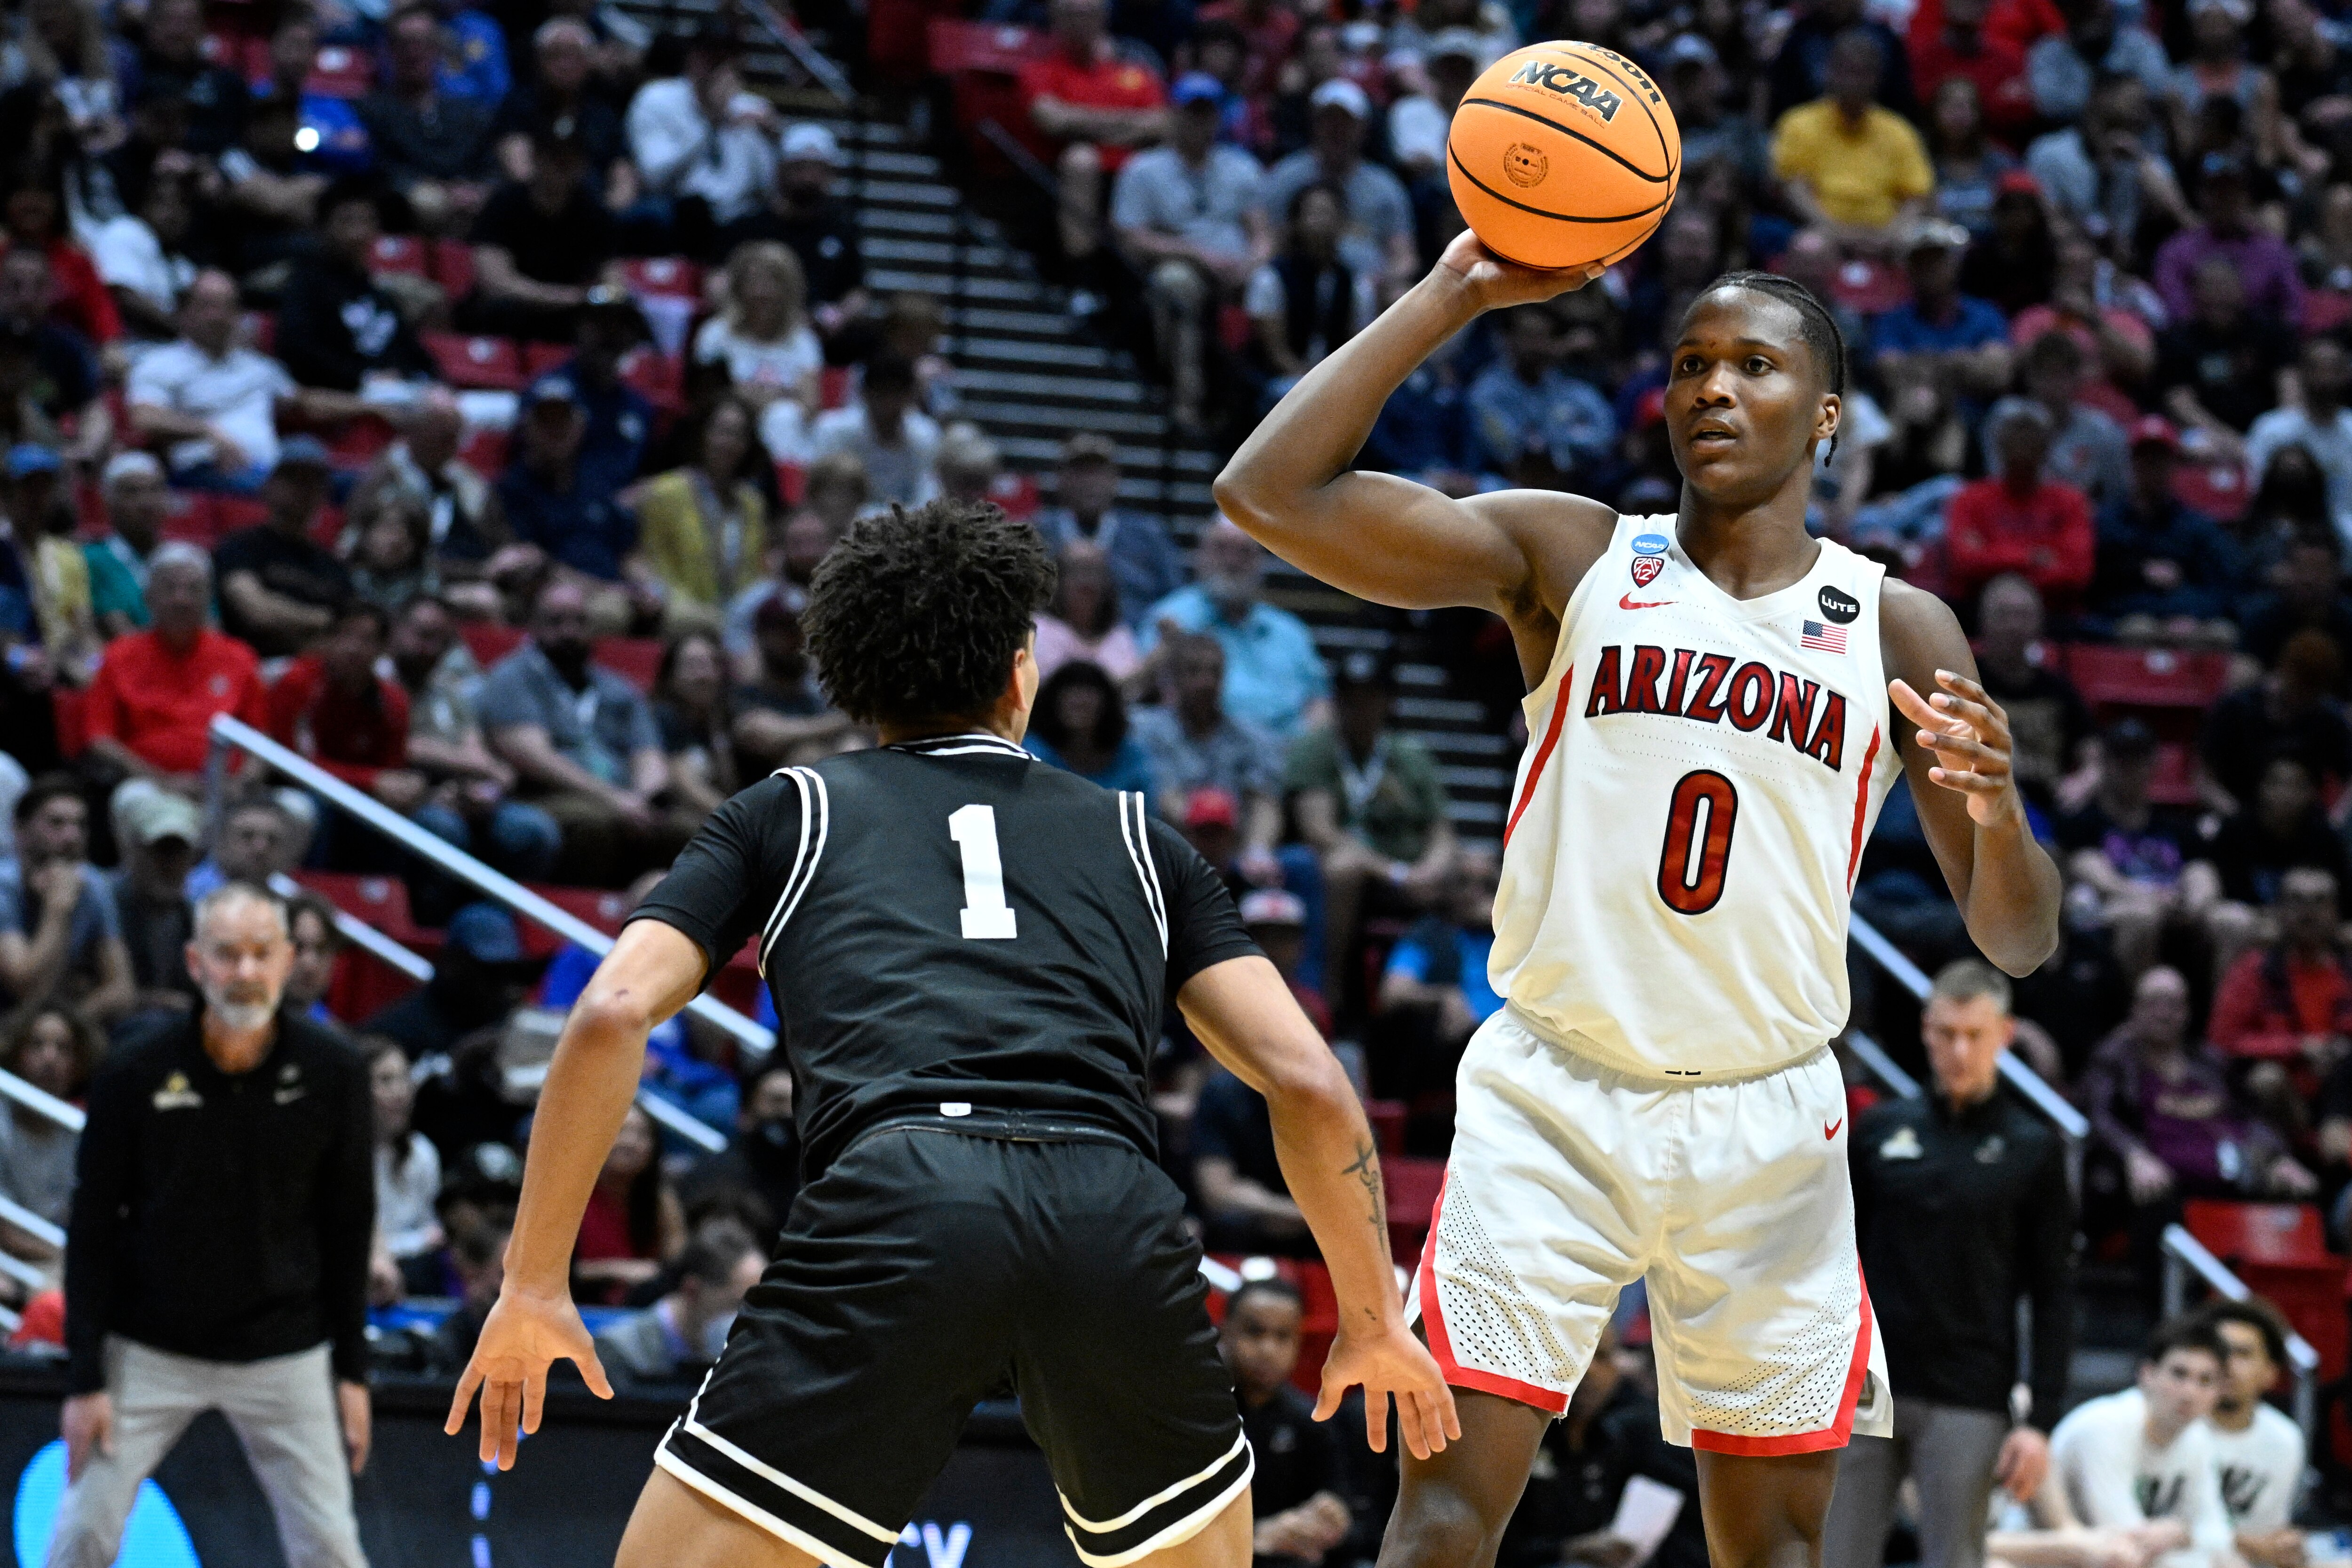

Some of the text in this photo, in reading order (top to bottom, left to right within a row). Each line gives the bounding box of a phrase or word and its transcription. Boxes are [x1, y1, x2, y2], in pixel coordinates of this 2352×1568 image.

[1509, 60, 1623, 124] NCAA
[1549, 94, 1579, 110] GAME
[1580, 109, 1605, 129] BALL
[1634, 558, 1662, 575] PAC
[1636, 568, 1653, 581] 12
[1821, 594, 1856, 613] LUTE
[1584, 645, 1846, 772] ARIZONA
[1657, 769, 1738, 915] 0
[948, 804, 1017, 939] 1
